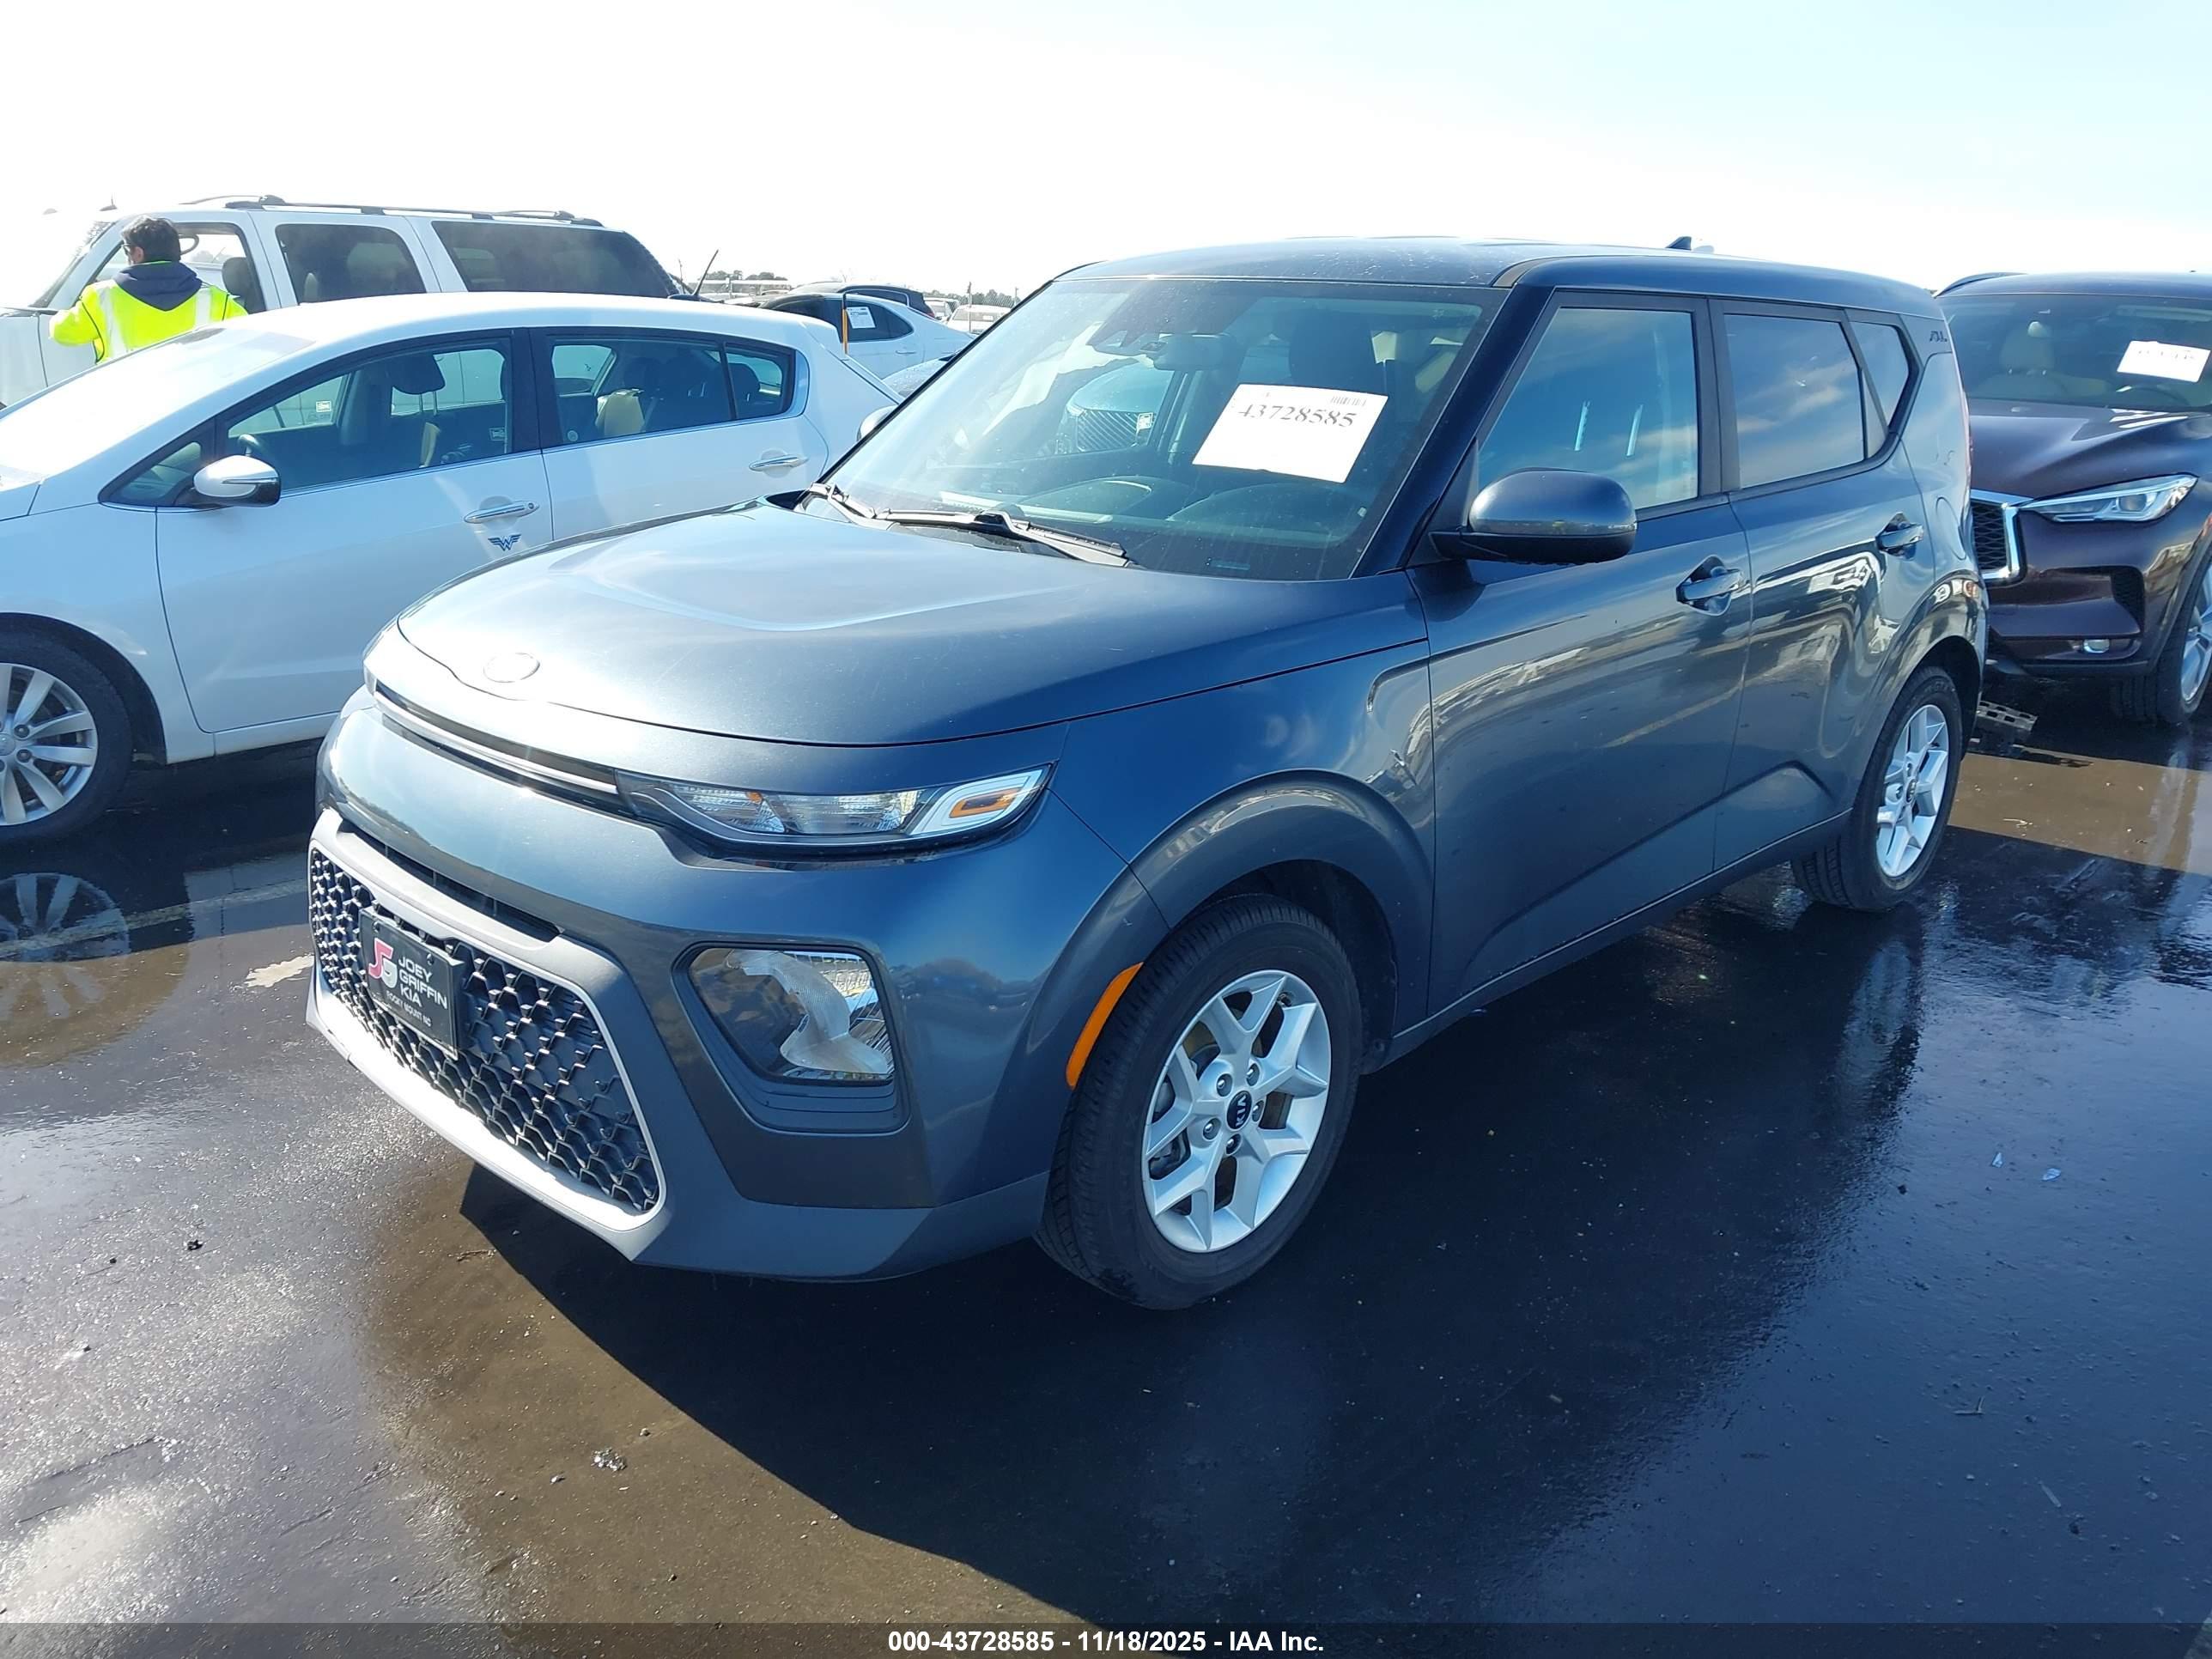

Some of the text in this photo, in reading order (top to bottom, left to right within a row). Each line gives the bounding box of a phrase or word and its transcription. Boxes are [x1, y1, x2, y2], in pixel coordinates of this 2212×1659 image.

[1238, 404, 1358, 428] 43728585
[398, 956, 433, 983] JOEY
[398, 969, 448, 1010] GRIFFIN
[400, 983, 422, 1008] KIA
[404, 1001, 422, 1021] MOUNT
[422, 1015, 432, 1027] NC
